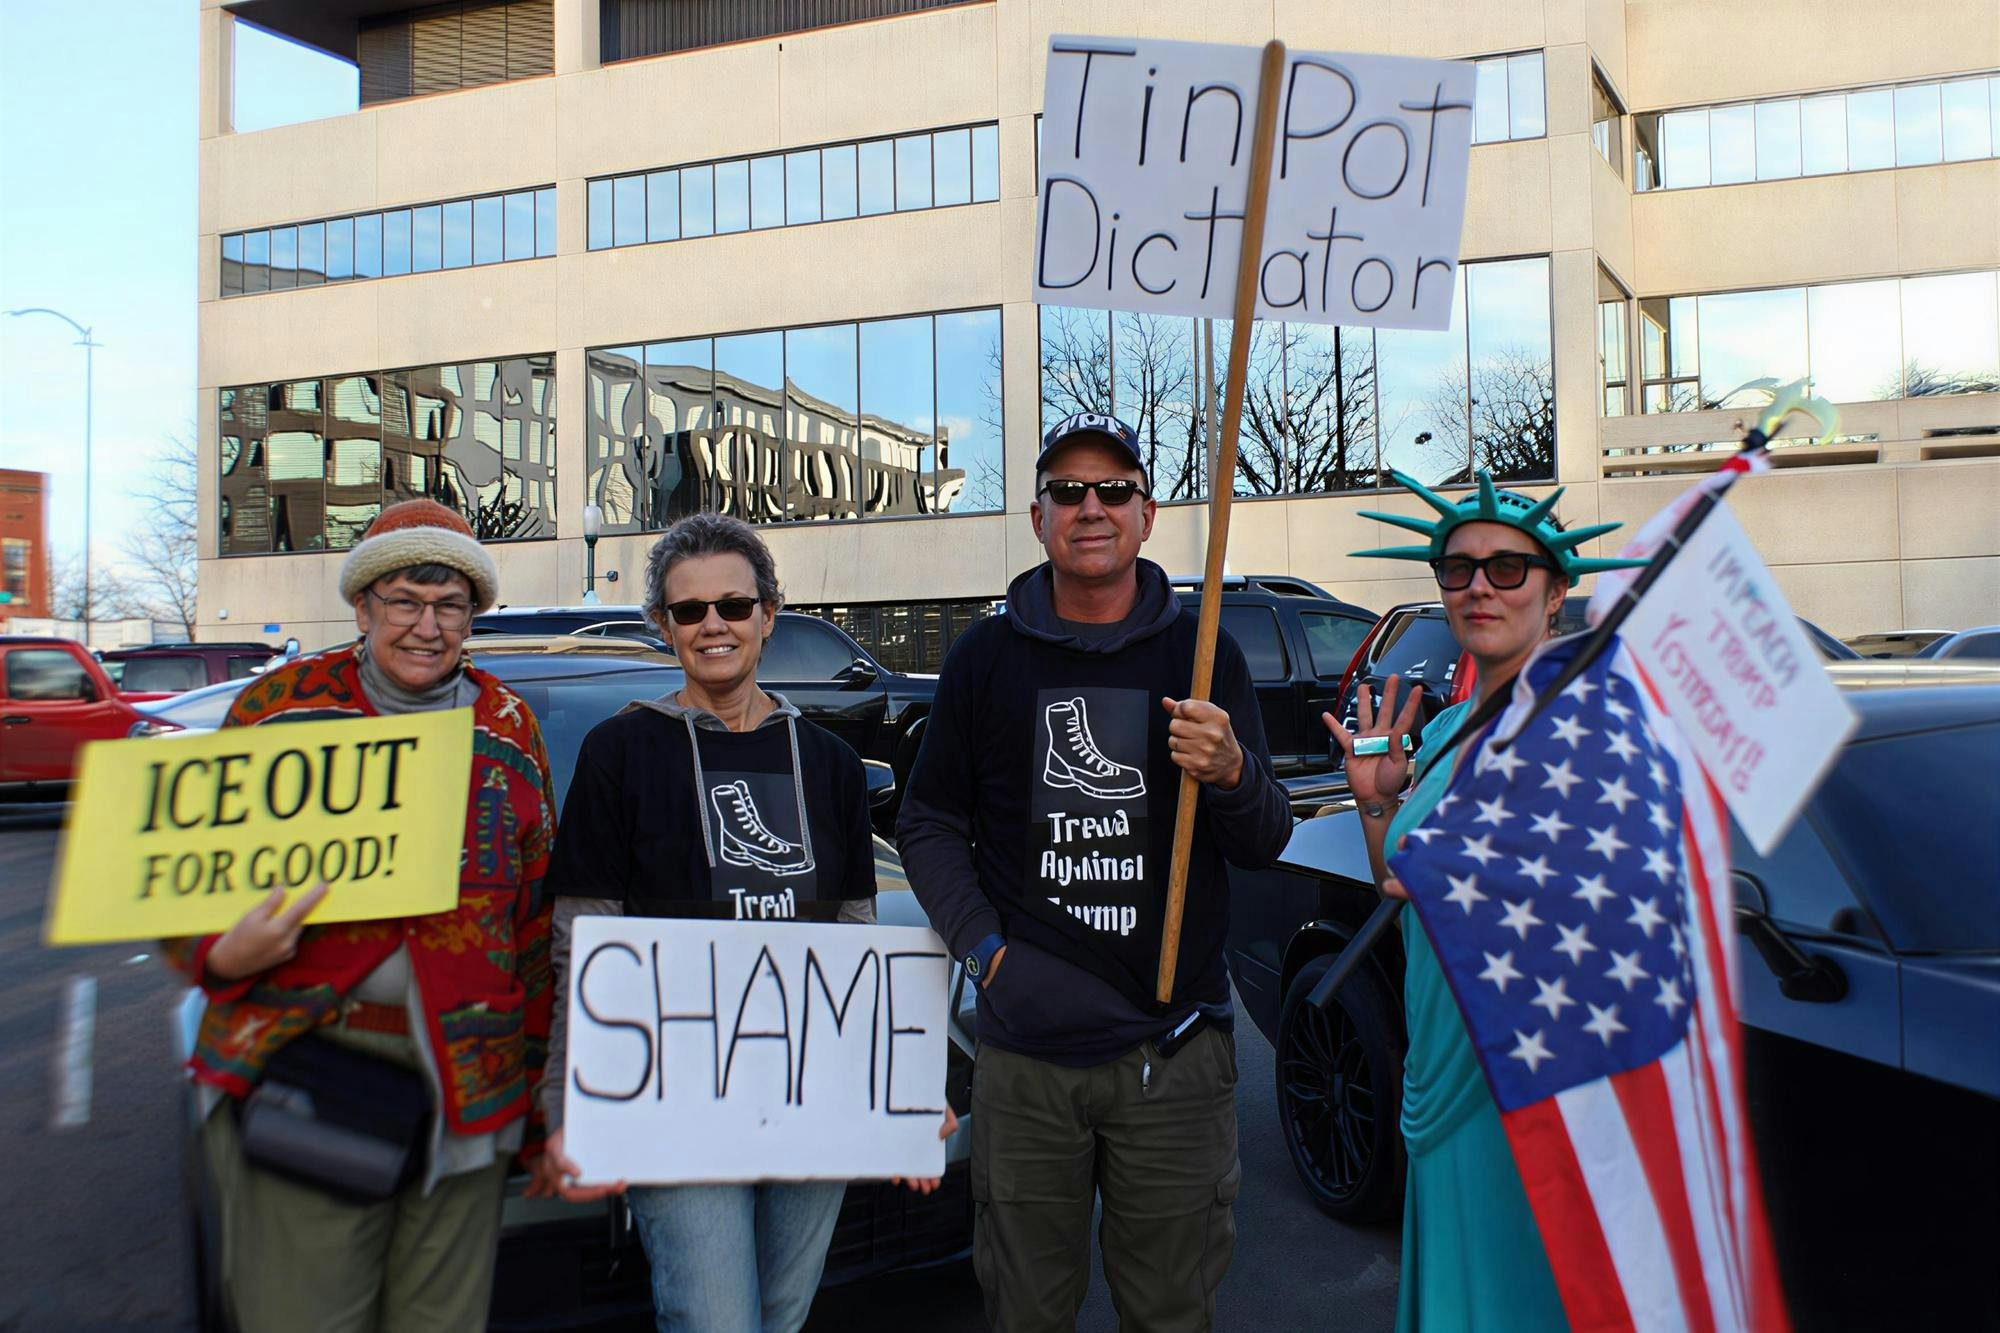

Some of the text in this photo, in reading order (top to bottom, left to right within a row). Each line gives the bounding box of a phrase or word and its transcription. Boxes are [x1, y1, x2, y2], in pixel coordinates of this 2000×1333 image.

[1052, 42, 1473, 208] Tin Pot
[1038, 176, 1453, 313] Dictator
[140, 737, 419, 833] ICE OUT
[140, 833, 399, 899] FOR GOOD!
[574, 940, 948, 1116] SHAME
